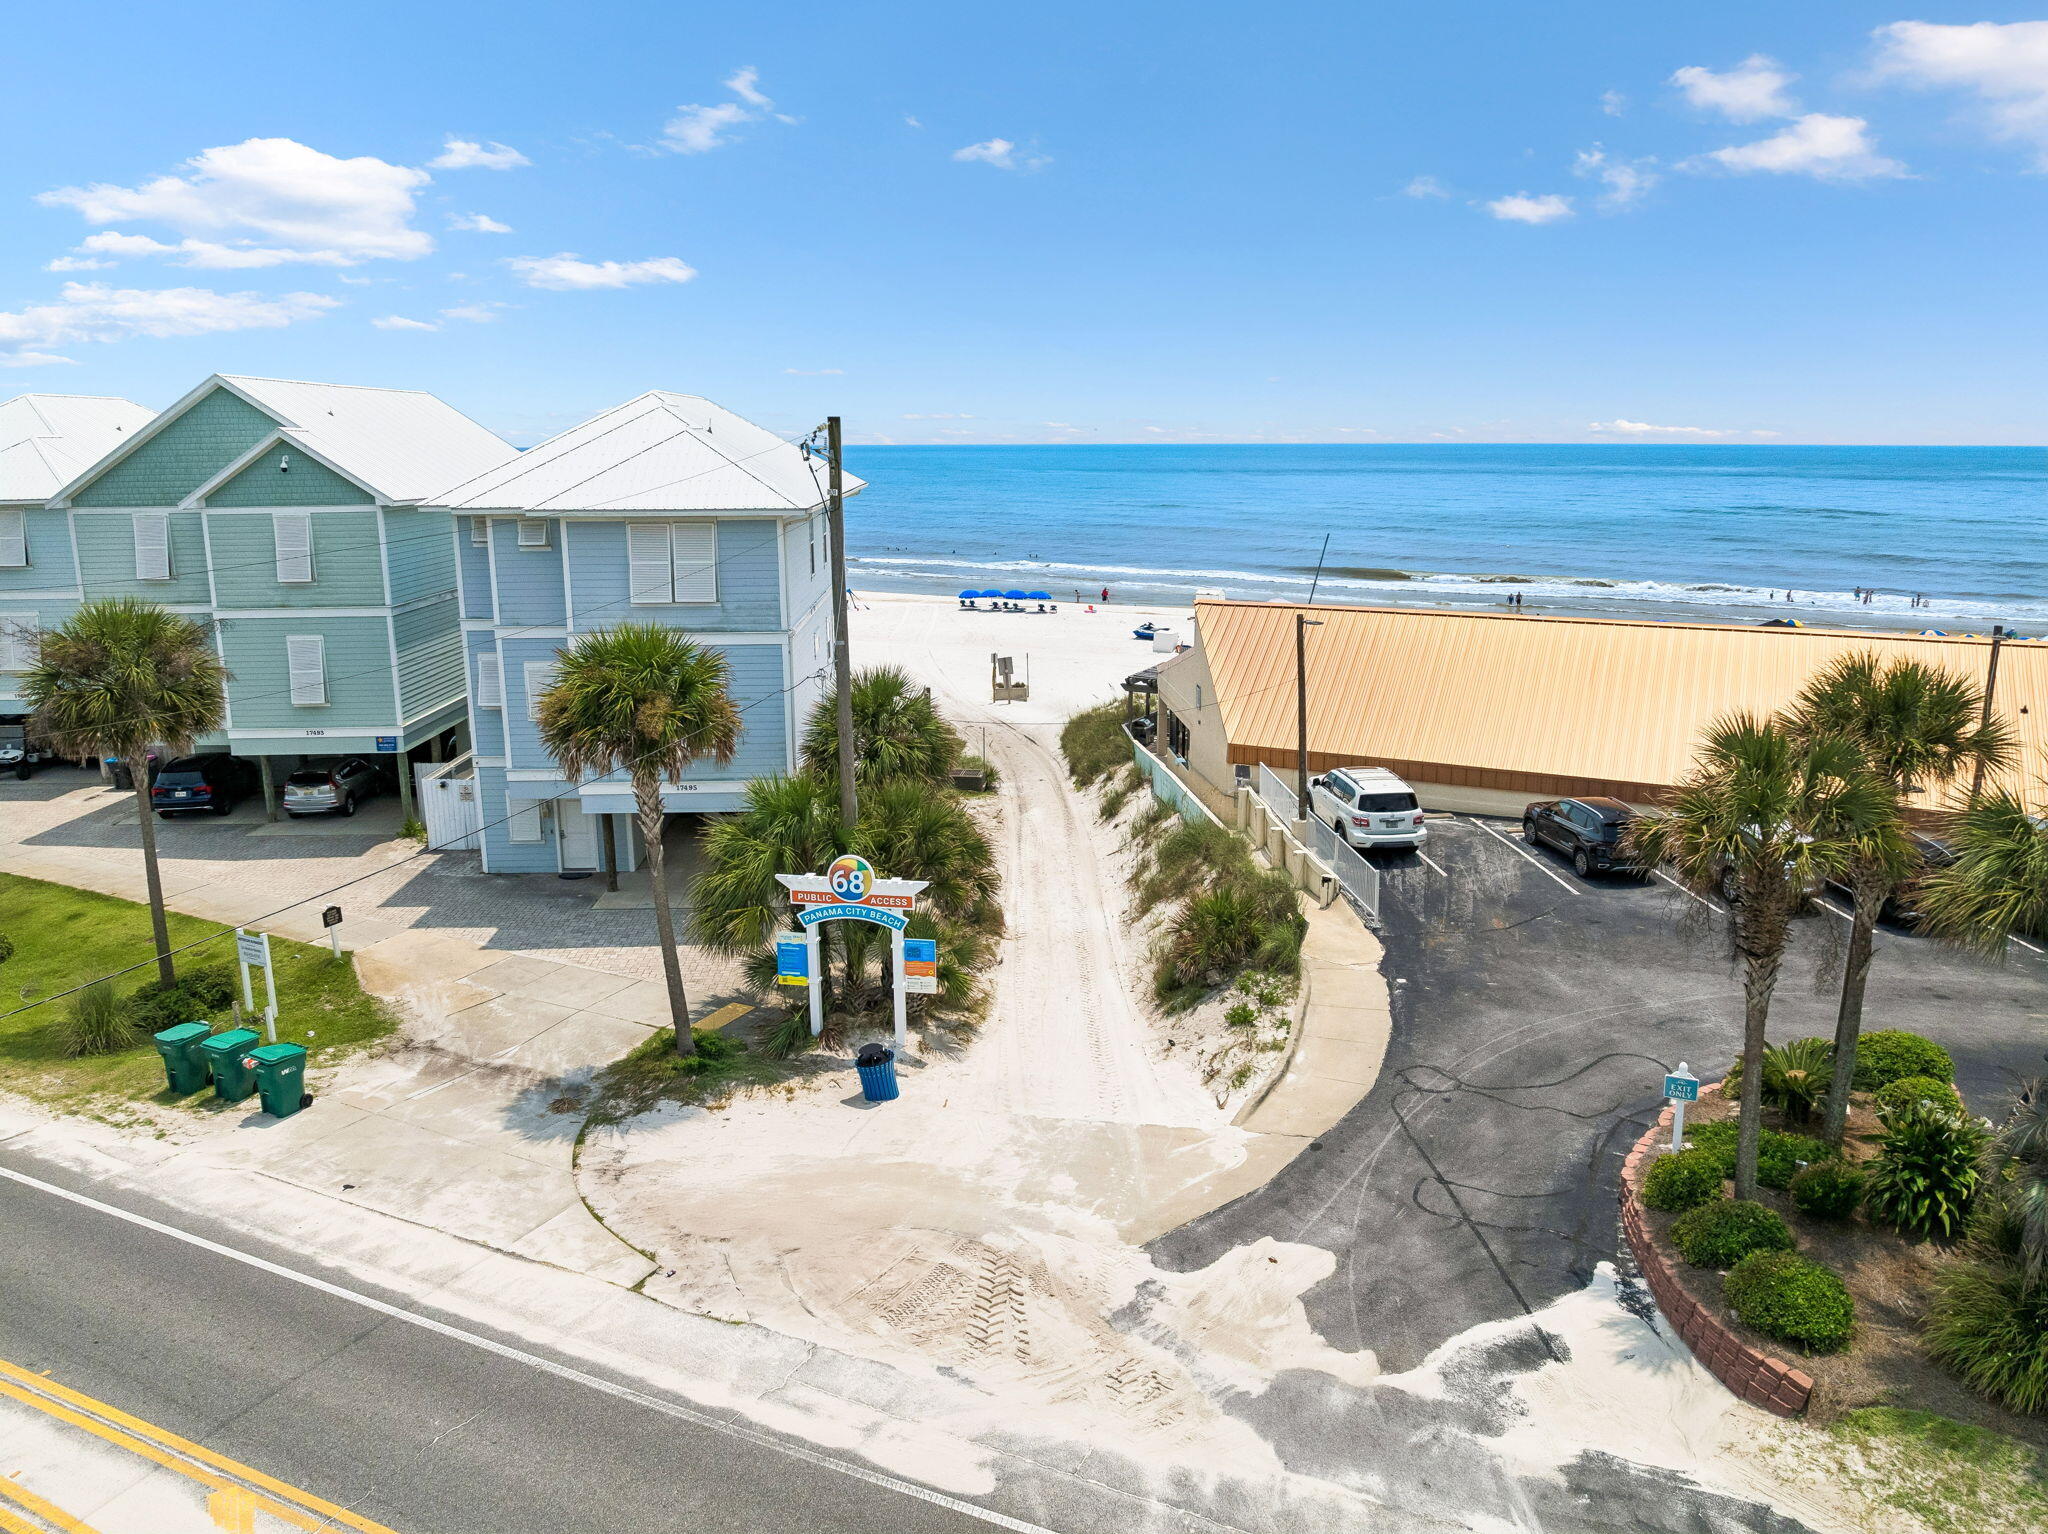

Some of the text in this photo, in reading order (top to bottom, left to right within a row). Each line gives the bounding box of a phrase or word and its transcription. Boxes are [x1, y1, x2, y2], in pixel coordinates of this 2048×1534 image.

[832, 870, 864, 893] 68
[797, 892, 908, 906] PUBLIC ACCESS
[804, 907, 902, 928] PANAMA CITY BEACH
[1669, 1090, 1693, 1099] ONLY
[1670, 1083, 1692, 1093] EXIT
